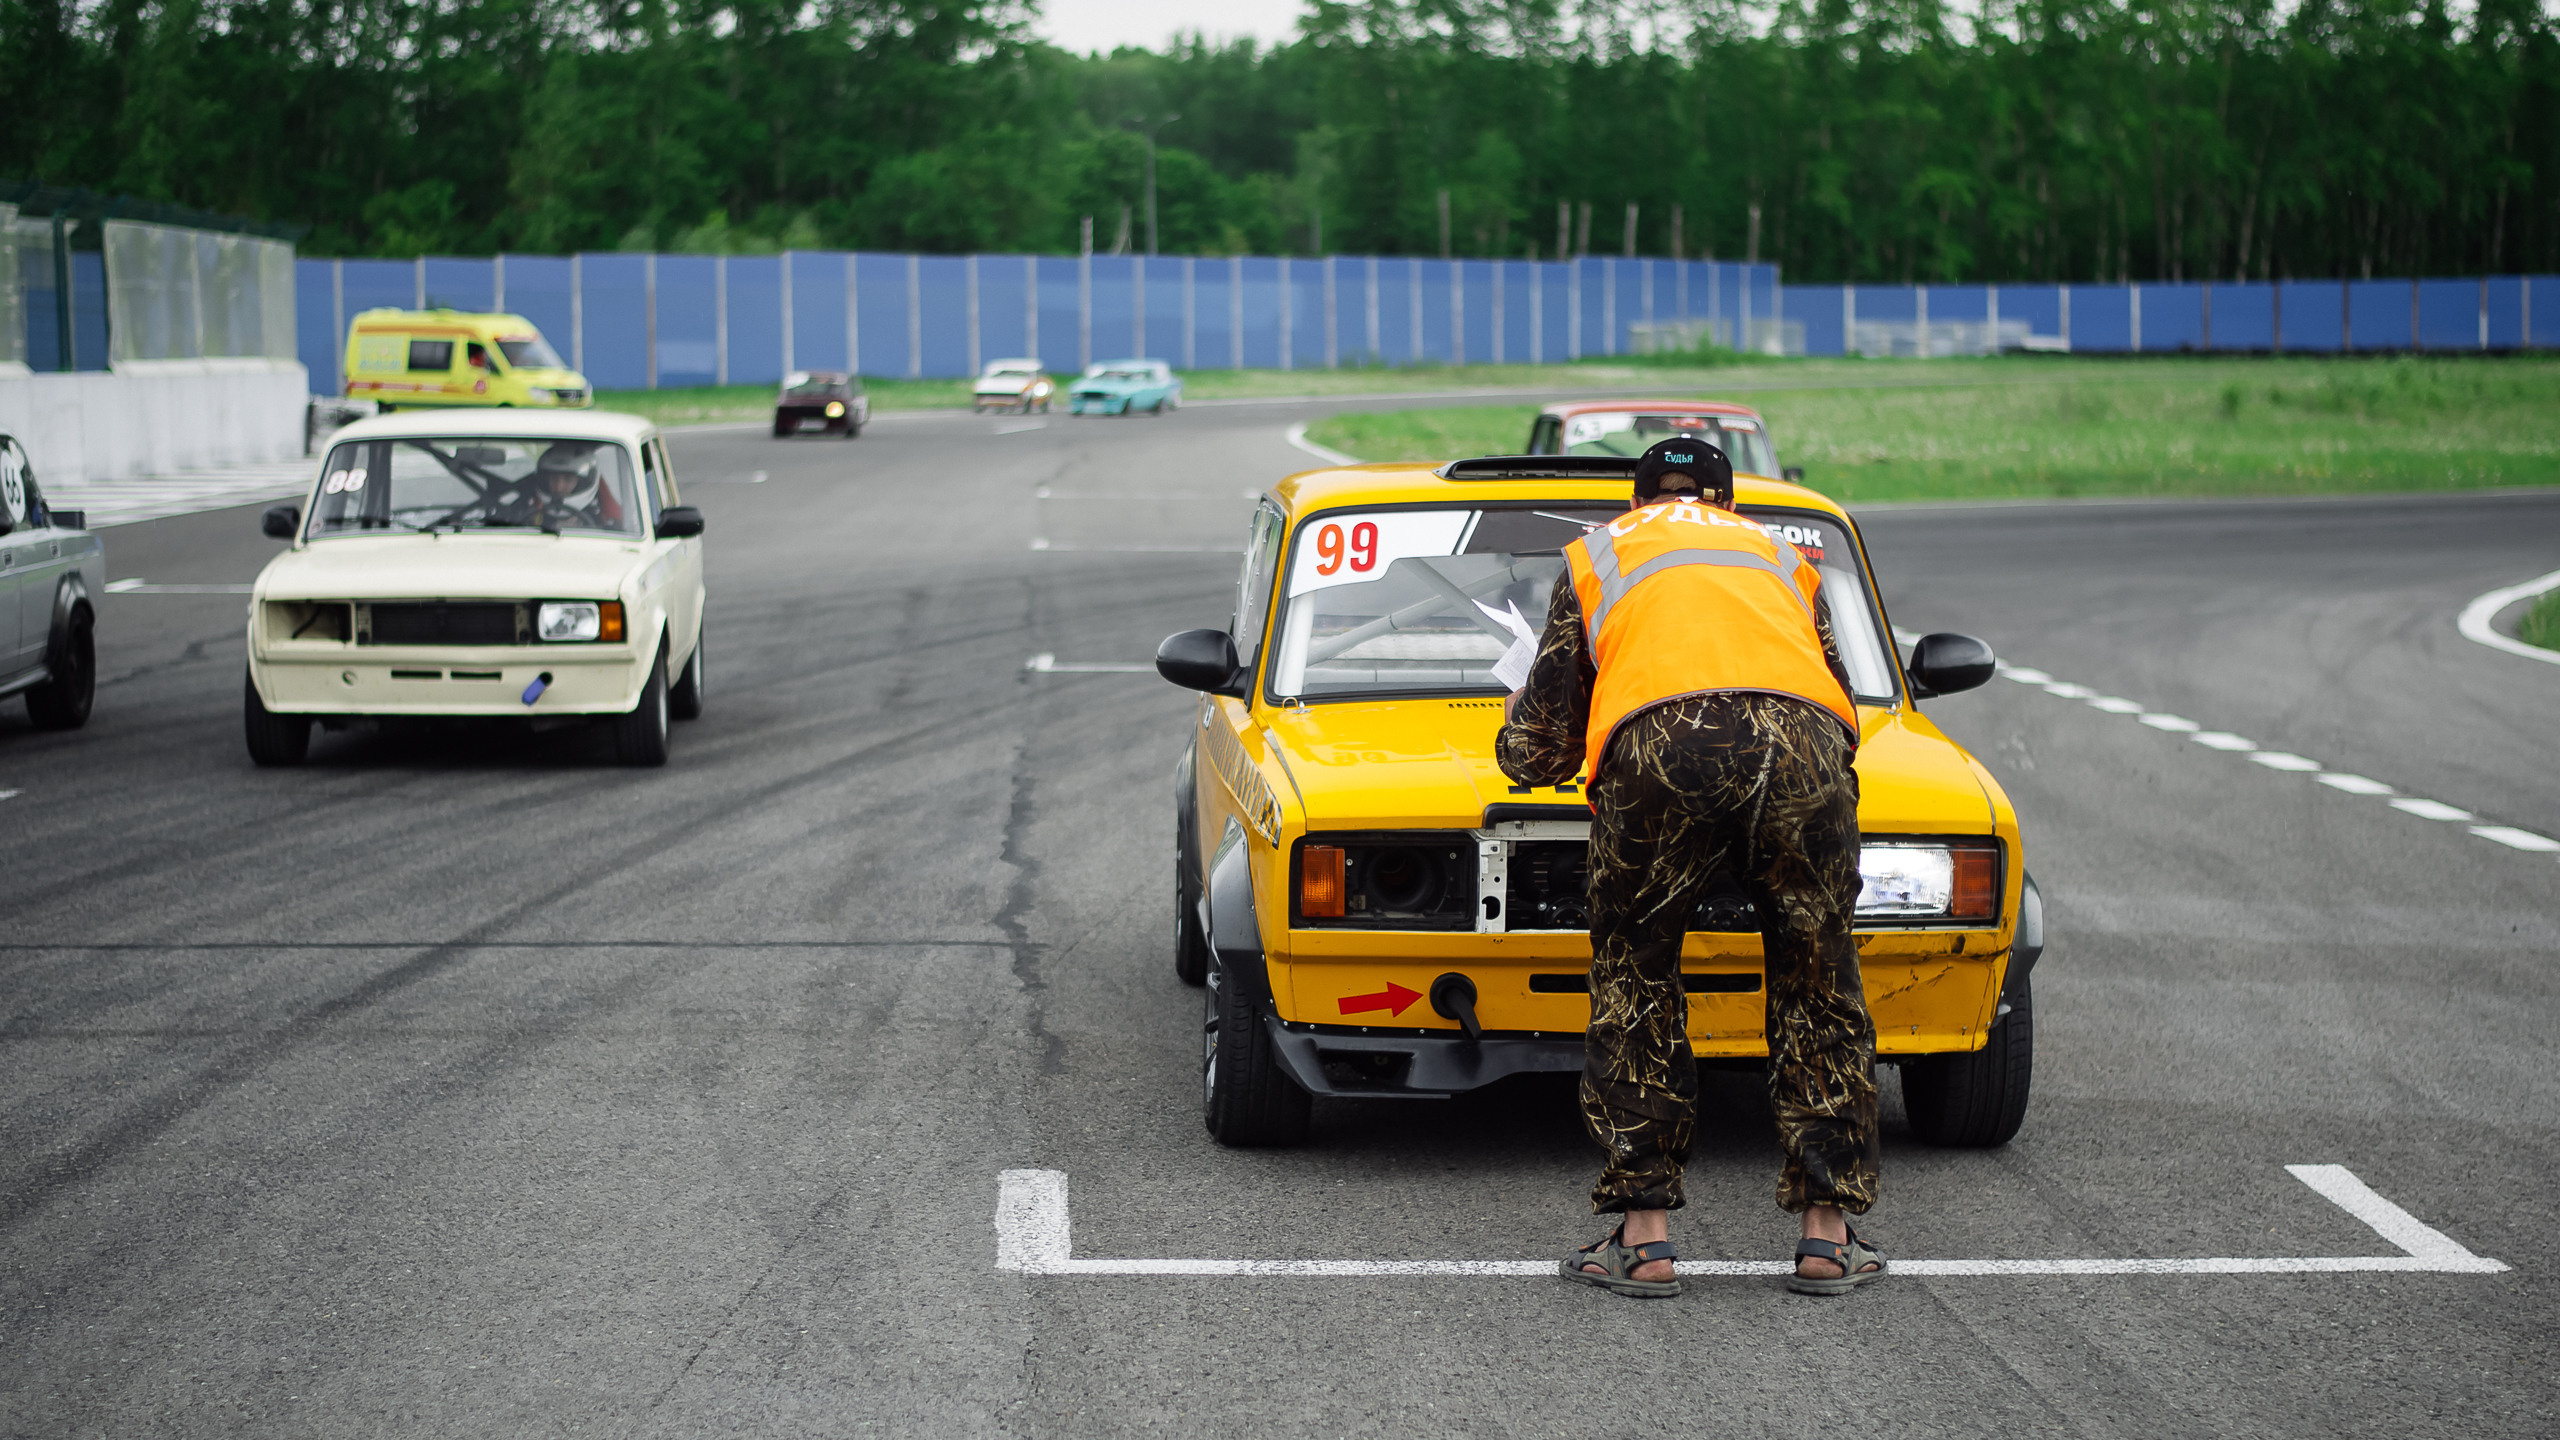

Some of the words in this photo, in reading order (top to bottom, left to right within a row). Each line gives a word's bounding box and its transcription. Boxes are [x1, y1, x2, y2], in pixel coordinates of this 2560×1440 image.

[1665, 454, 1694, 464] СУДЬЯ
[326, 468, 368, 495] 88
[1607, 504, 1771, 538] СУДЬЯ
[1316, 521, 1379, 577] 99
[1796, 545, 1825, 560] КИ
